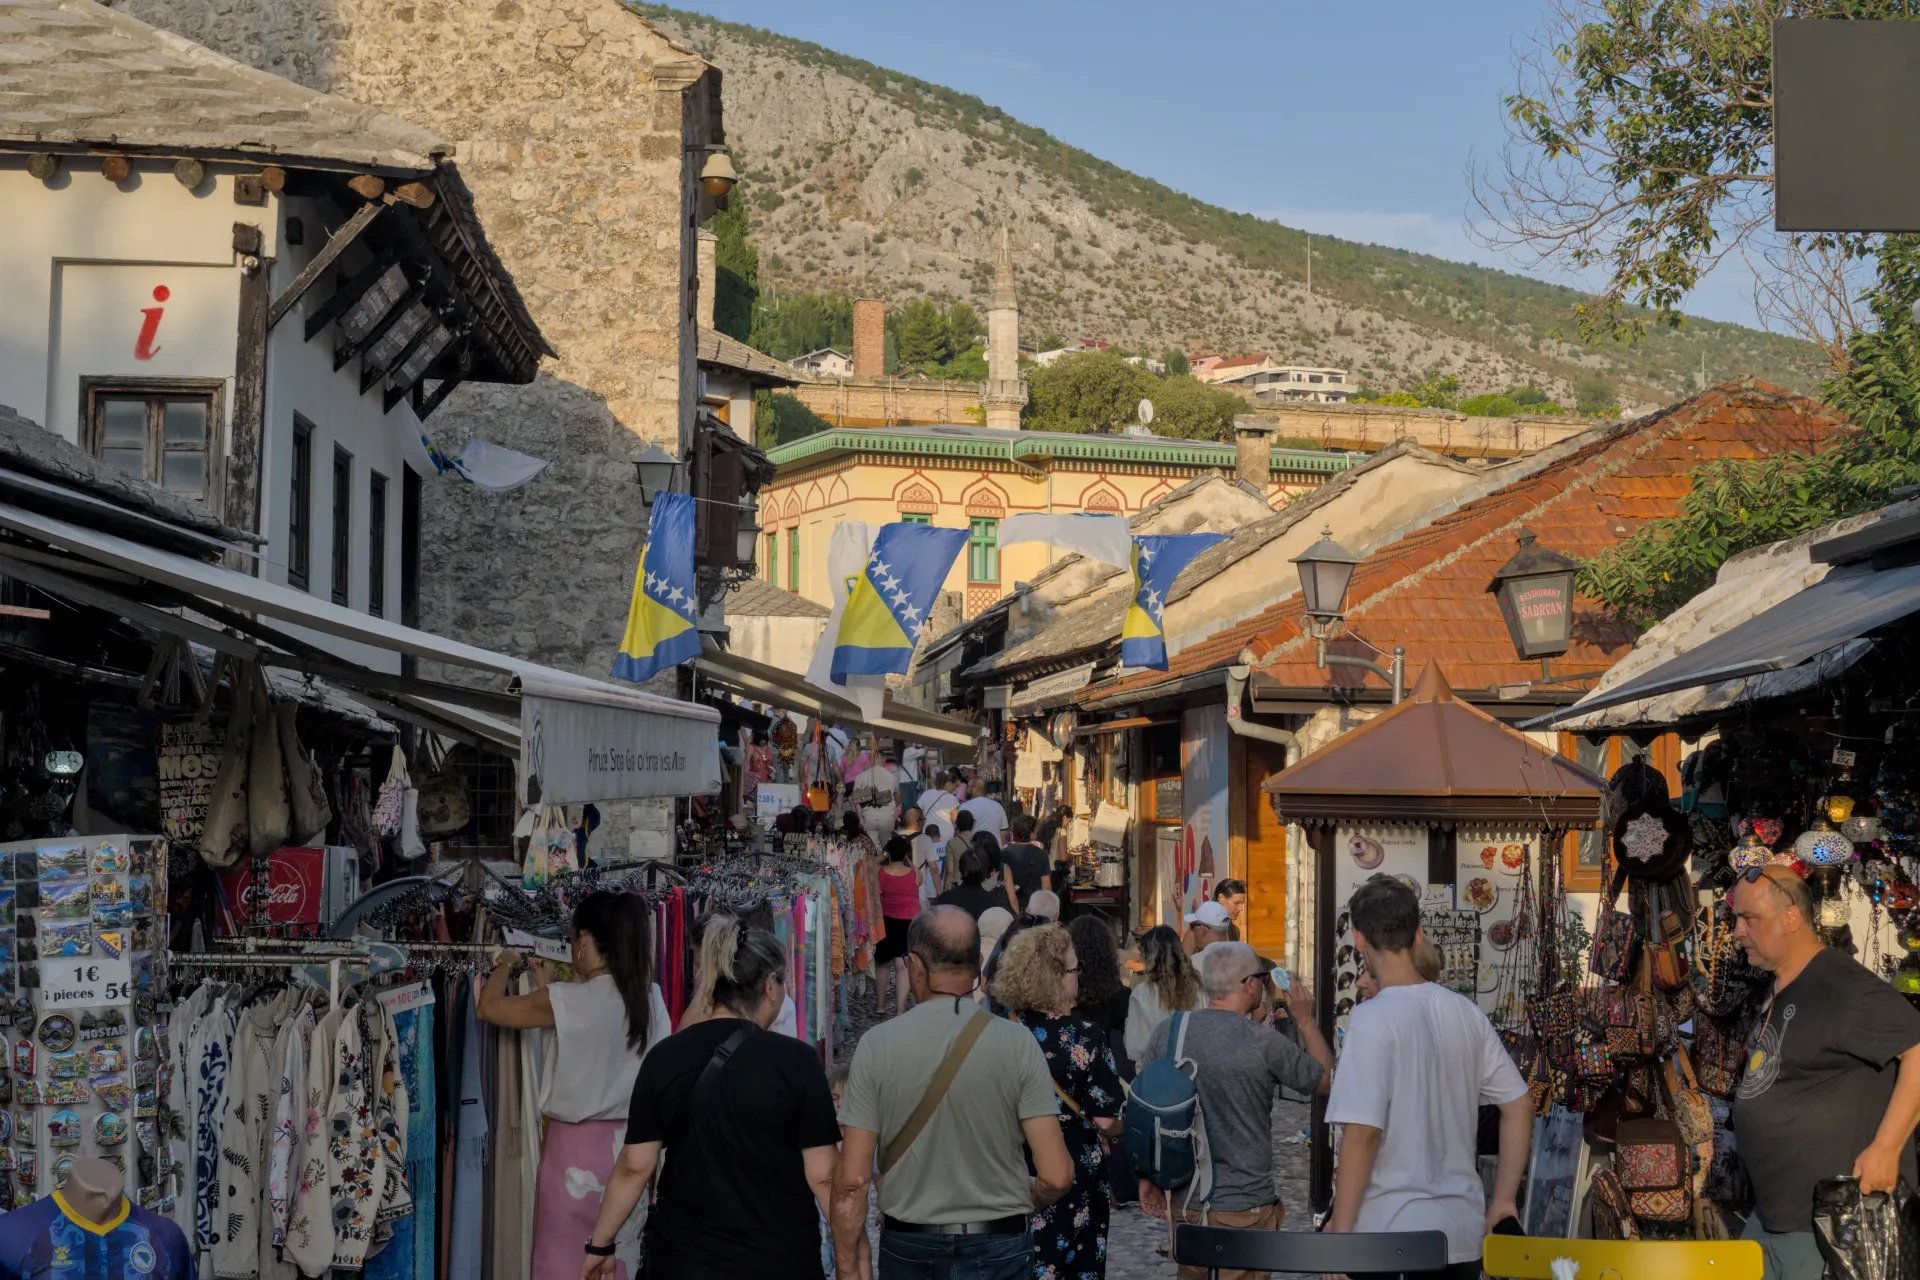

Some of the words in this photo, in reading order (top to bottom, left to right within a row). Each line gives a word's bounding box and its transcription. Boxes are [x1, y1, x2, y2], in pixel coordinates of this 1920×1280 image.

[1519, 588, 1561, 602] RESTAURANT
[158, 754, 221, 780] MOS
[91, 891, 125, 900] MOSTAR
[1425, 888, 1431, 900] 2
[74, 966, 99, 982] 1€
[53, 989, 94, 1002] pieces
[105, 982, 131, 1000] 5€
[79, 1024, 128, 1040] MOSTAR
